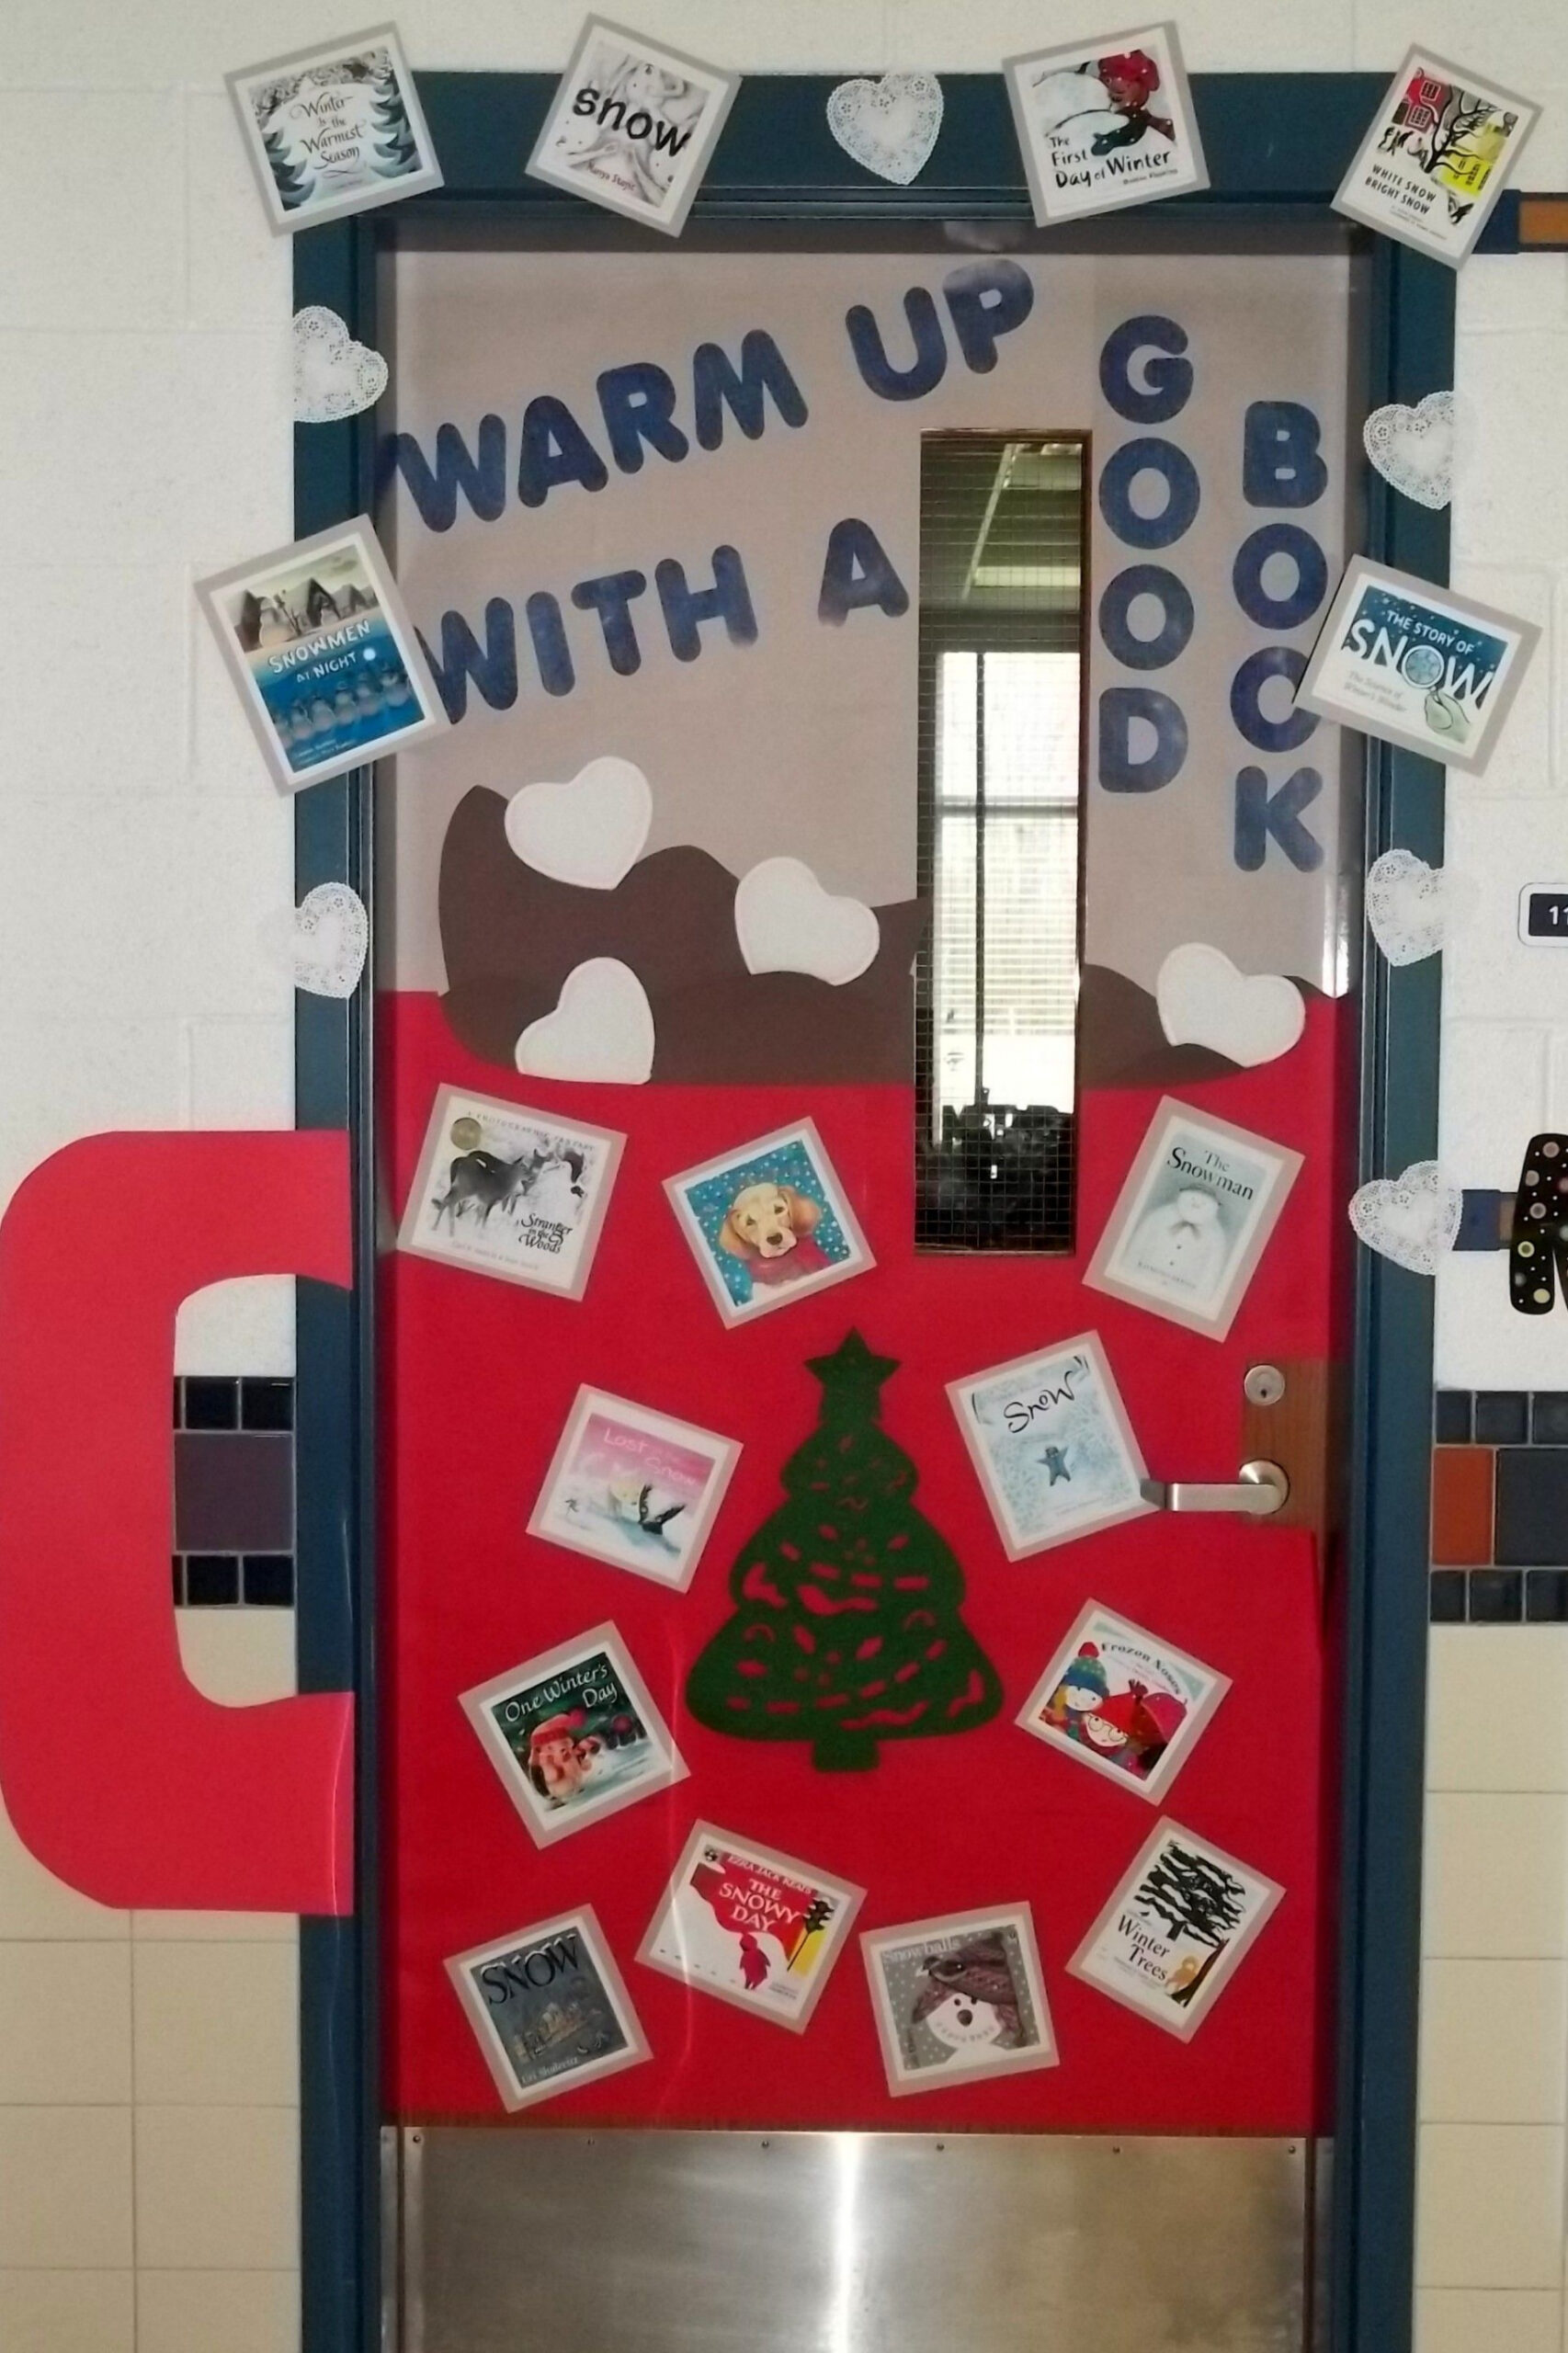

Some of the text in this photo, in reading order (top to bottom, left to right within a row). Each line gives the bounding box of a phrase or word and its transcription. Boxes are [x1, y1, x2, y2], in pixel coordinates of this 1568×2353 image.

[290, 92, 354, 119] Winter
[331, 116, 346, 128] the
[573, 88, 692, 156] snow
[300, 119, 367, 154] Warmest
[1049, 136, 1071, 149] The
[313, 145, 360, 169] Season
[1051, 149, 1087, 167] First
[1055, 169, 1092, 188] Day
[1095, 166, 1106, 180] of
[1106, 151, 1171, 176] Winter
[1364, 176, 1431, 215] BRIGHT SNOW
[1371, 165, 1437, 202] WHITE SNOW
[393, 258, 1035, 533] WARM UP
[1099, 314, 1200, 793] GOOD
[414, 517, 910, 725] WITH A
[1230, 401, 1329, 872] BOOK
[1386, 608, 1475, 655] THE STORY OF
[267, 620, 371, 674] SNOWMEN
[312, 652, 358, 678] NIGHT
[1346, 618, 1495, 710] SNOW
[1166, 1146, 1255, 1200] Snowman
[1204, 1149, 1230, 1173] The
[518, 1233, 562, 1255] Woods
[521, 1212, 573, 1244] Stranger
[604, 1427, 649, 1453] Lost
[644, 1456, 697, 1486] Snow
[505, 1663, 608, 1722] One Winter's
[582, 1683, 618, 1709] Day
[719, 1882, 801, 1925] SNOWY
[748, 1879, 782, 1900] THE
[732, 1905, 777, 1931] DAY
[1118, 1915, 1170, 1958] Winter
[481, 1933, 580, 2006] SNOW
[1128, 1944, 1167, 1981] Trees
